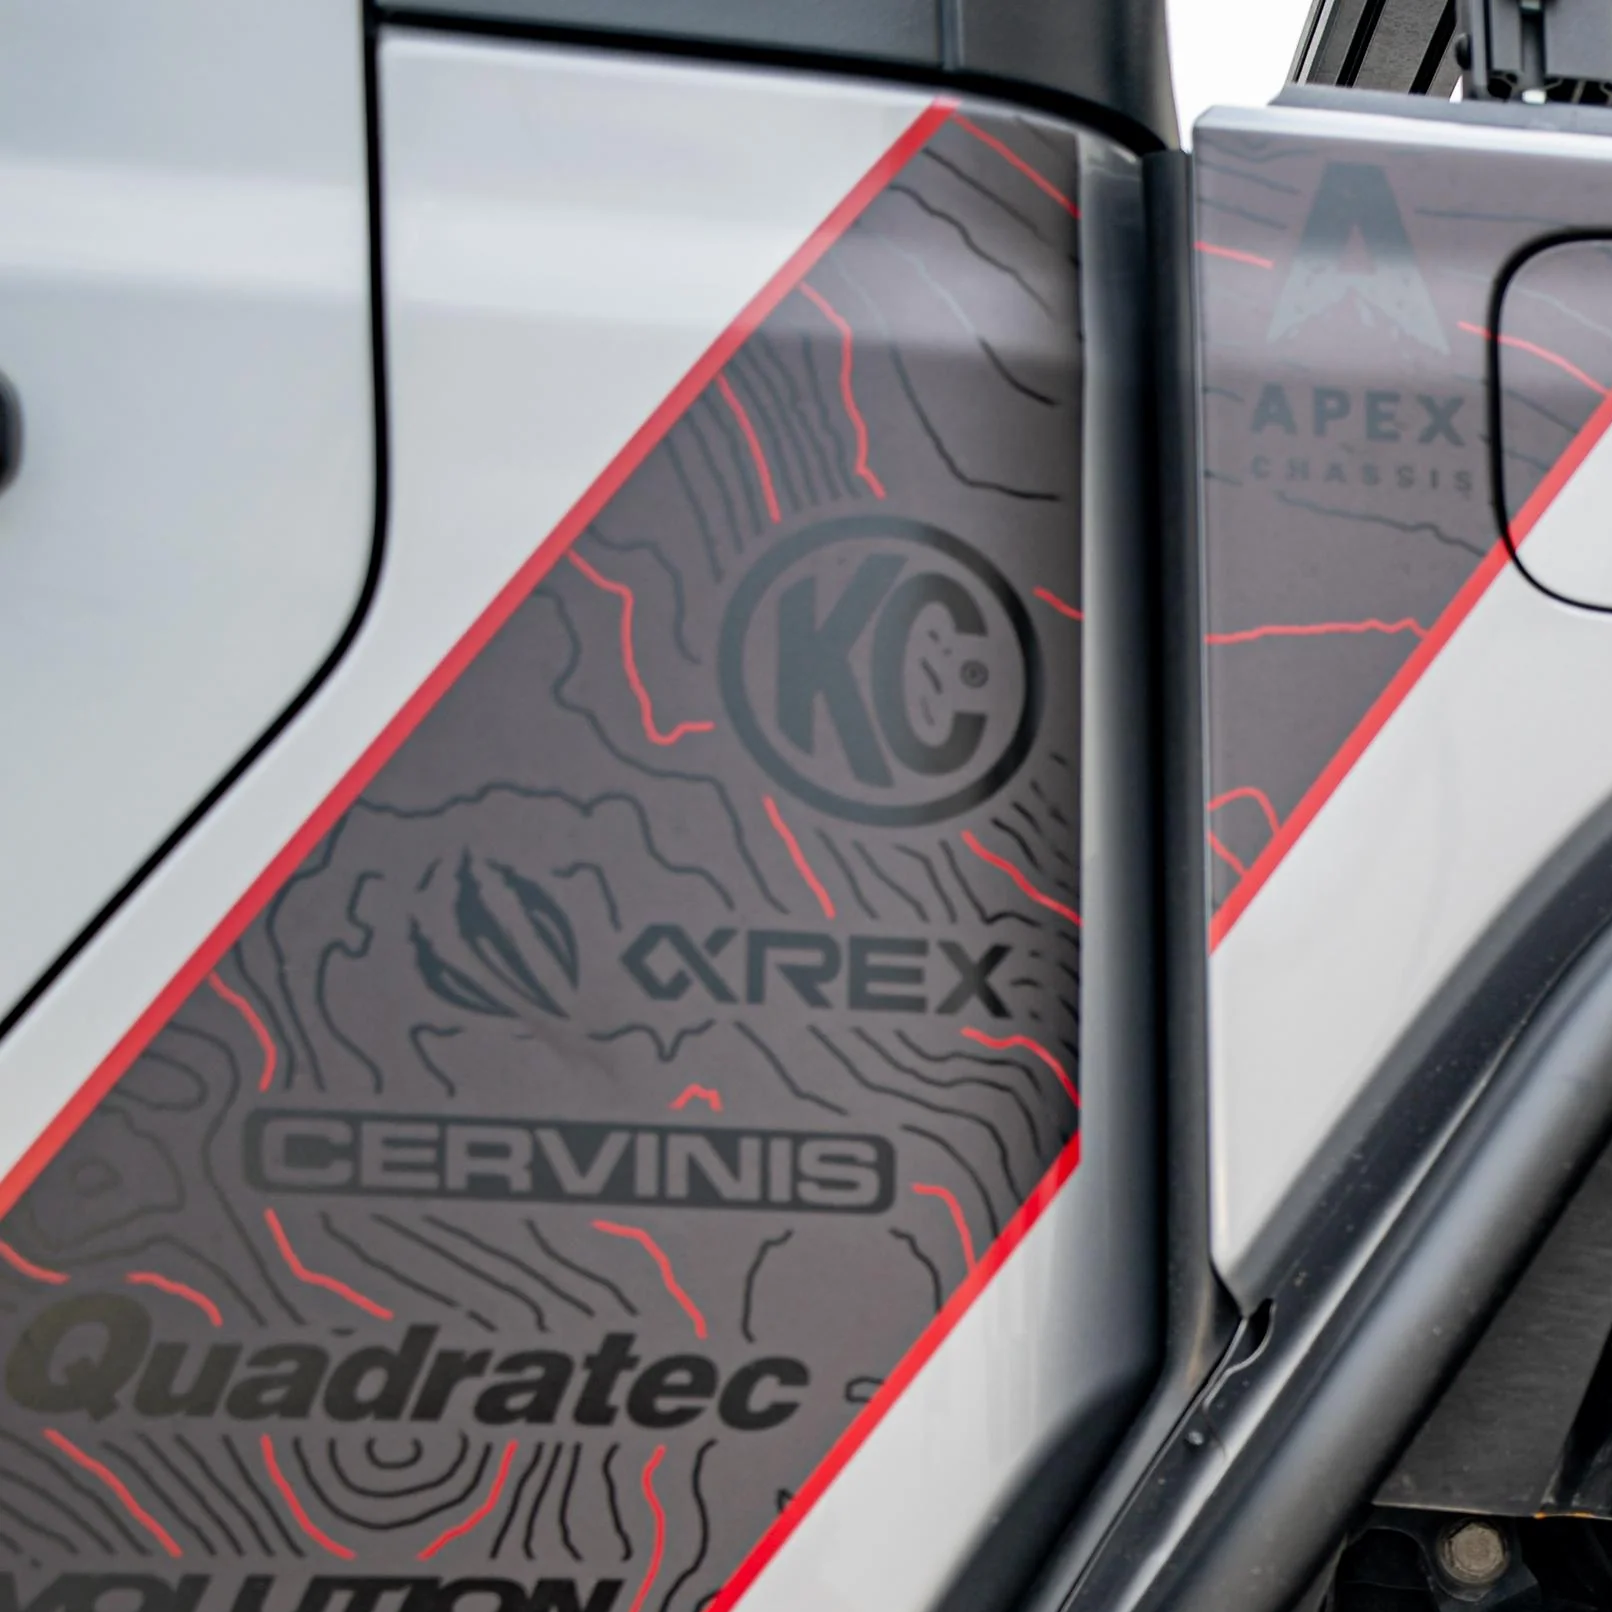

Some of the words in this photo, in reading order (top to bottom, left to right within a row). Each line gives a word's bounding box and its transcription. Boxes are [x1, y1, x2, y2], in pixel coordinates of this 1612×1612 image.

[1250, 382, 1467, 447] APEX
[1251, 454, 1473, 495] CHASSIS
[258, 1117, 883, 1206] CERVINIS
[5, 1291, 810, 1432] Quadratec
